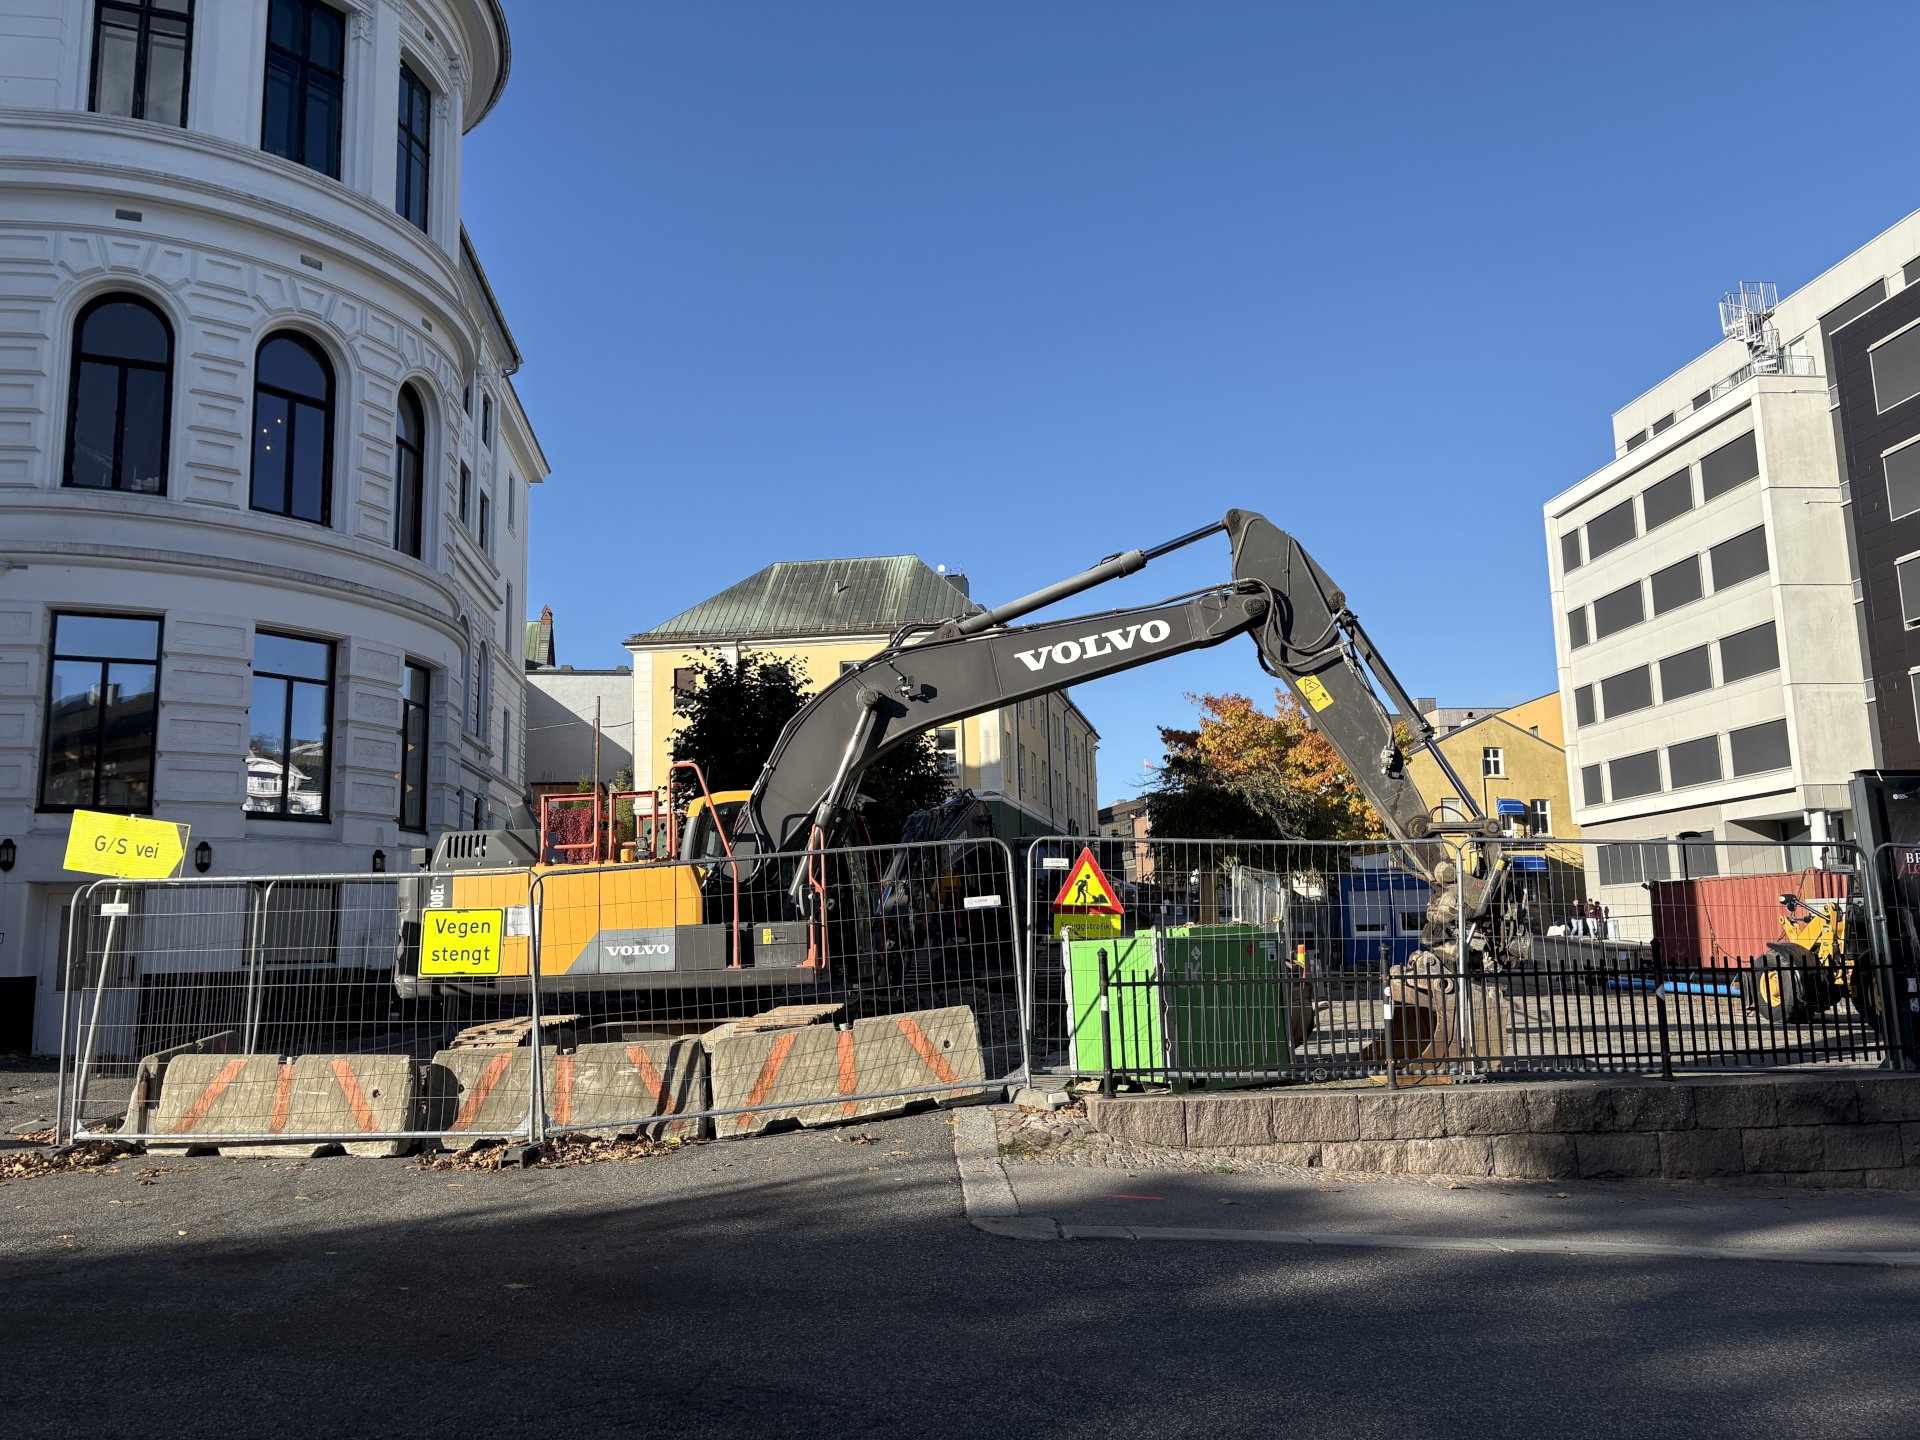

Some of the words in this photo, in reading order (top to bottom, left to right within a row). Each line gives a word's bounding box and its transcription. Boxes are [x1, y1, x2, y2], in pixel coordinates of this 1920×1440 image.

[1013, 619, 1171, 672] VOLVO
[94, 835, 128, 855] G/S
[136, 842, 160, 859] vei
[430, 883, 445, 908] 00EL
[435, 918, 491, 939] Vegen
[431, 946, 491, 966] stengt
[605, 944, 670, 957] VOLVO
